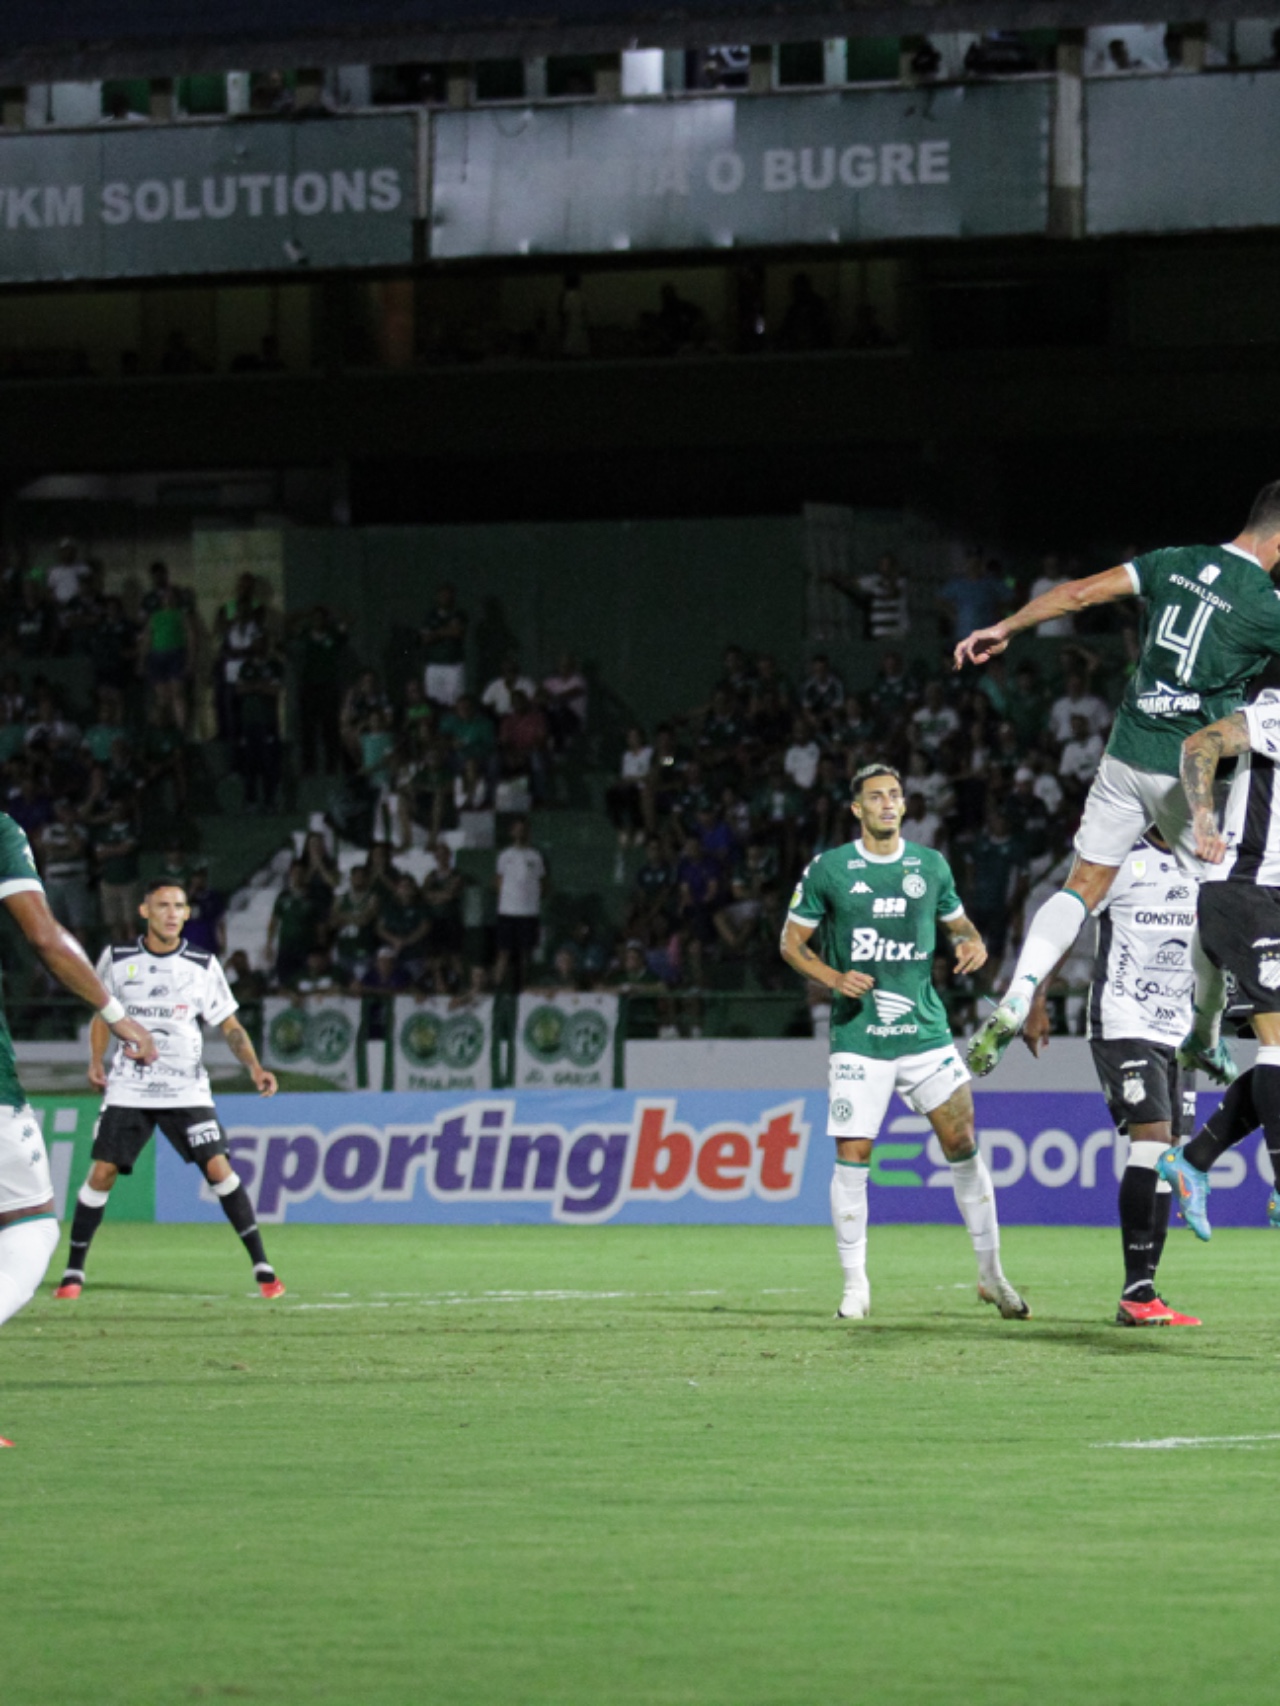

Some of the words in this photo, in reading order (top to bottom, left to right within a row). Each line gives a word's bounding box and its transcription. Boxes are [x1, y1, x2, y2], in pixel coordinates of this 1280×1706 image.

[0, 185, 83, 229] KM
[101, 166, 401, 225] SOLUTIONS
[709, 153, 744, 194] O
[763, 139, 950, 192] BUGRE
[1154, 600, 1215, 684] 4
[1135, 912, 1195, 927] CONSTRU
[229, 1107, 801, 1214] sportingbet
[869, 1116, 1247, 1188] Espors
